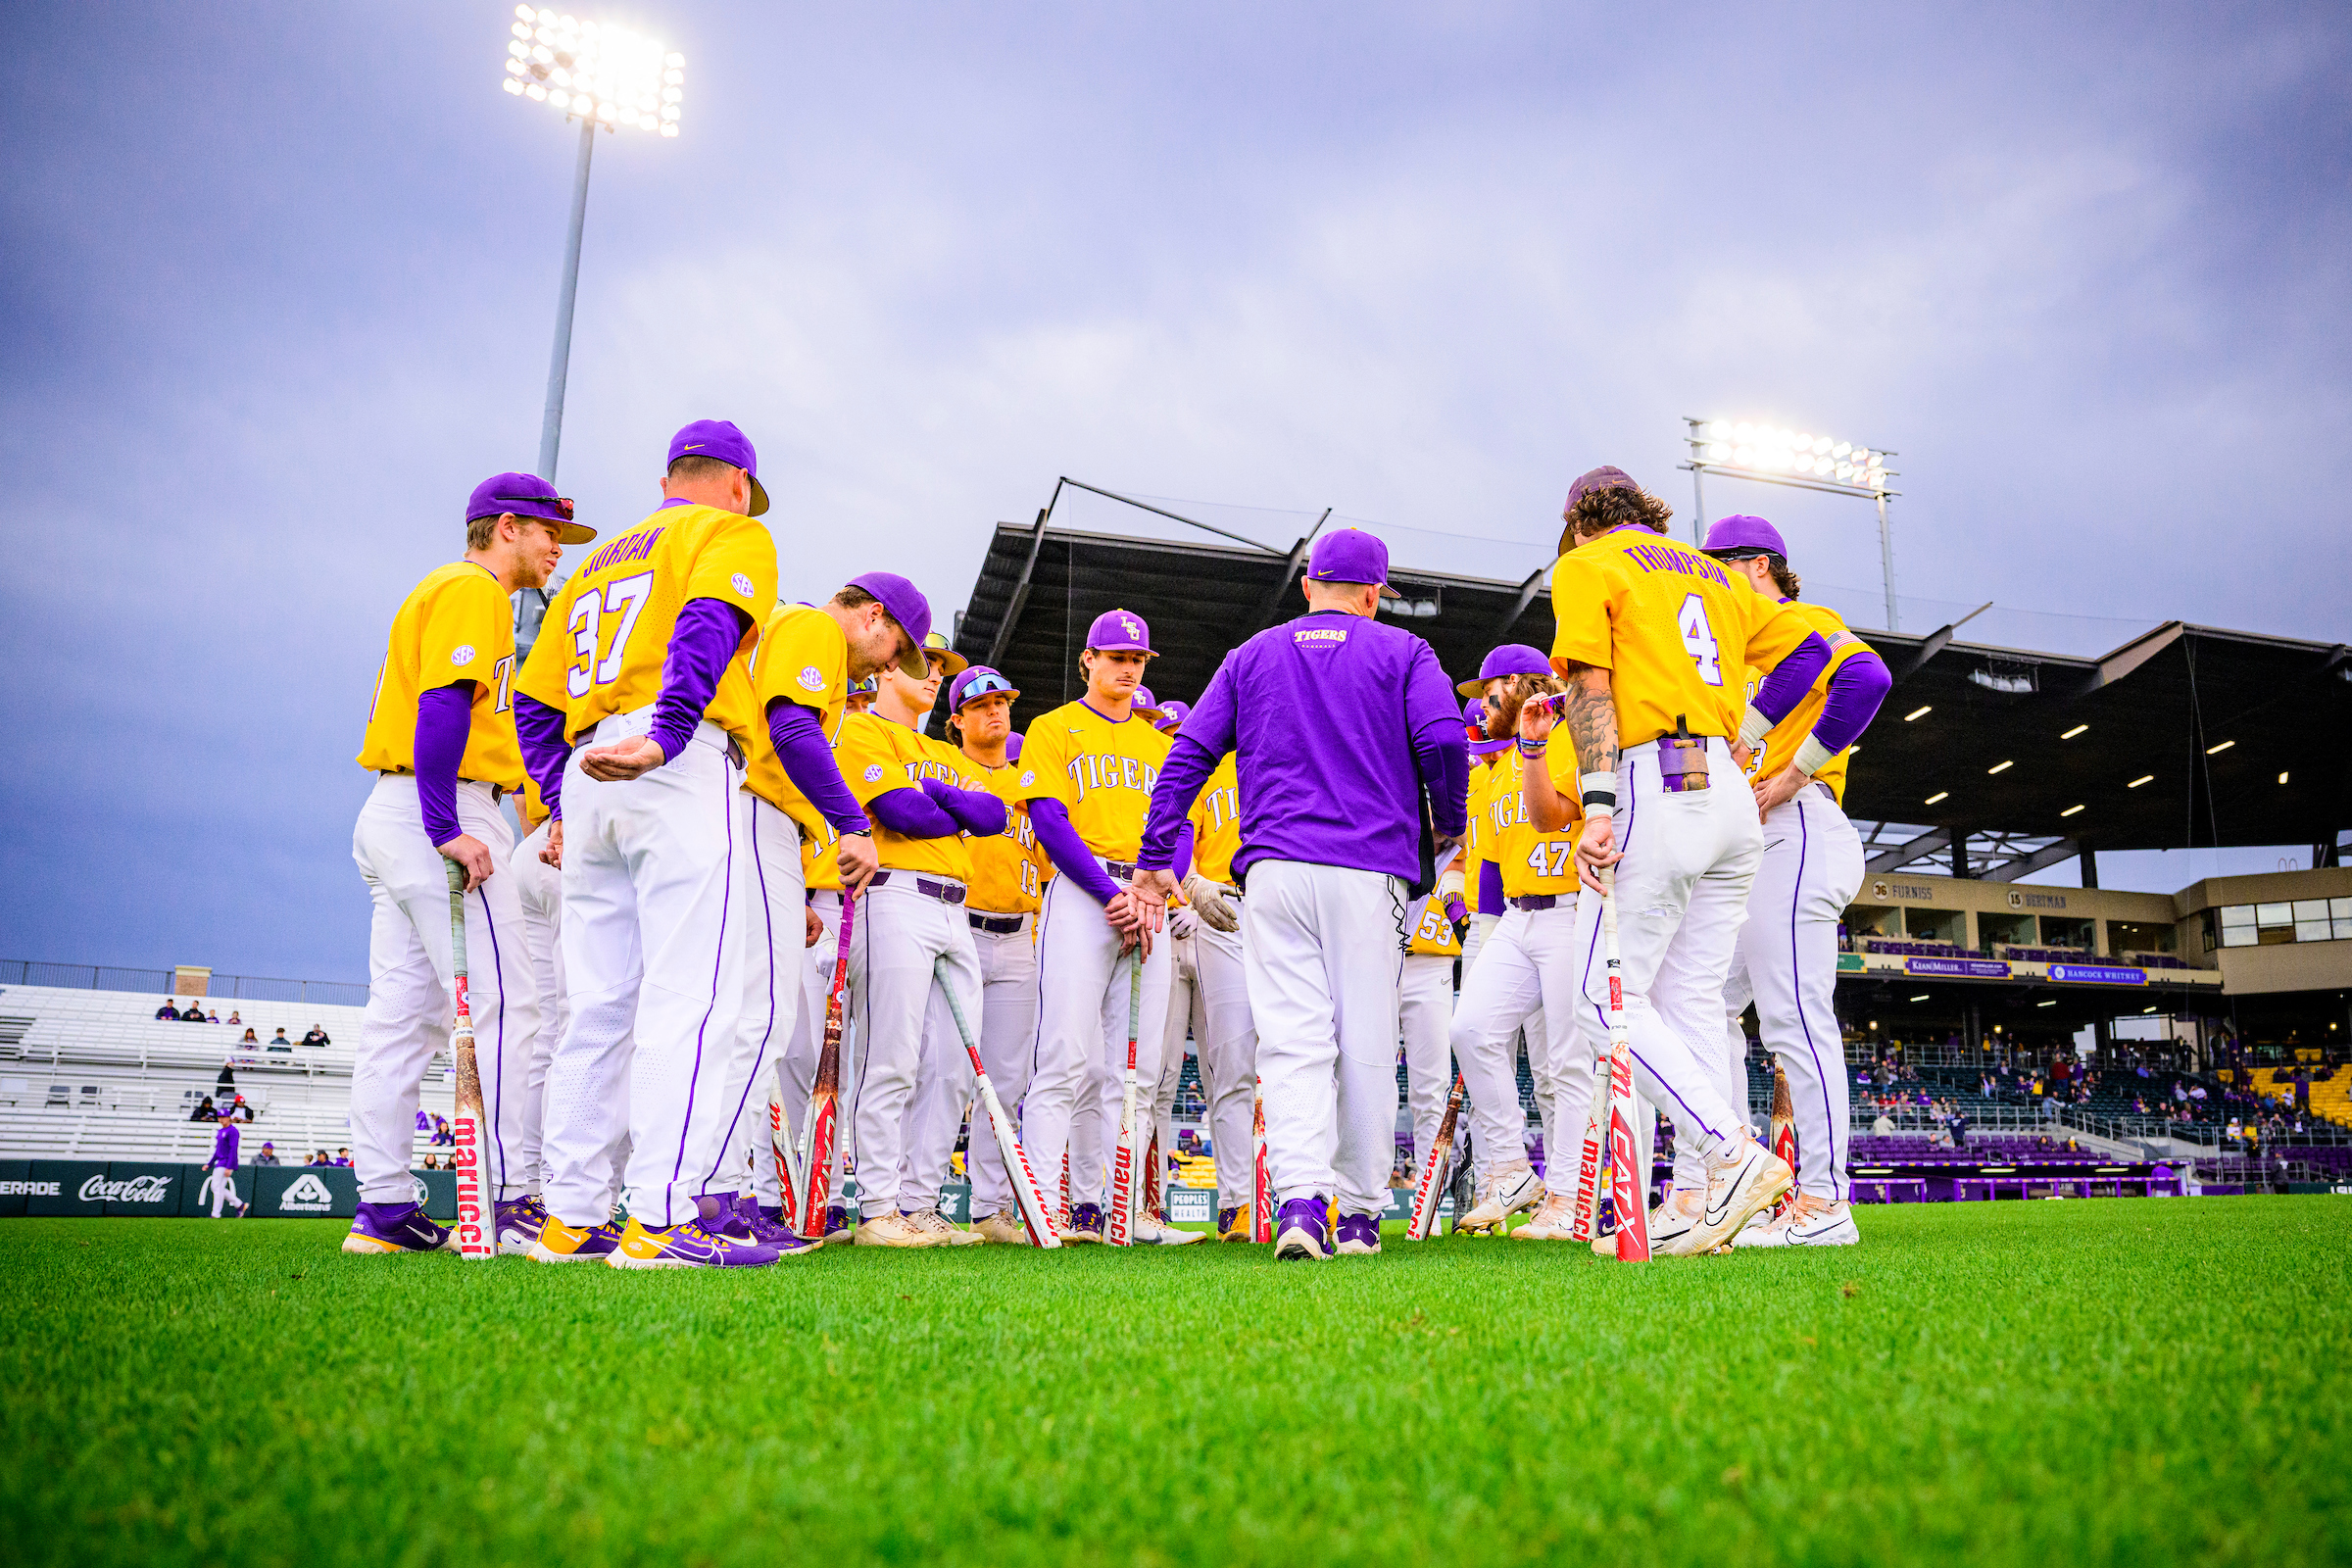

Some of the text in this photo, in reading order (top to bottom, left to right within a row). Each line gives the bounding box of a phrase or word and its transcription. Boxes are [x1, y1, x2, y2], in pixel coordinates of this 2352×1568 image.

[583, 527, 666, 578] JORDAN
[1623, 544, 1733, 592] THOMPSON
[733, 574, 754, 597] SEC
[566, 569, 655, 700] 37
[1121, 615, 1141, 641] LSU
[1295, 629, 1348, 642] TIGERS
[1678, 592, 1724, 687] 4
[453, 646, 474, 665] SEC
[802, 666, 822, 686] SEC
[1159, 705, 1179, 721] LSU
[1067, 752, 1159, 805] TIGER
[1528, 841, 1572, 877] 47
[1020, 858, 1039, 899] 13
[1892, 885, 1933, 900] FURNISS
[2011, 894, 2021, 905] 15
[1419, 910, 1454, 948] 53
[2067, 969, 2140, 981] HANCOCK WHITNEY
[0, 1180, 61, 1196] ERADE
[78, 1174, 173, 1202] Coca-Cola
[455, 1118, 491, 1254] marucci
[1013, 1144, 1059, 1238] marucci
[1110, 1145, 1132, 1248] marucci
[1173, 1194, 1208, 1205] PEOPLES
[1407, 1149, 1440, 1240] marucci
[1573, 1139, 1599, 1243] marucci
[279, 1201, 332, 1212] Albertsons
[1174, 1207, 1207, 1218] HEALTH
